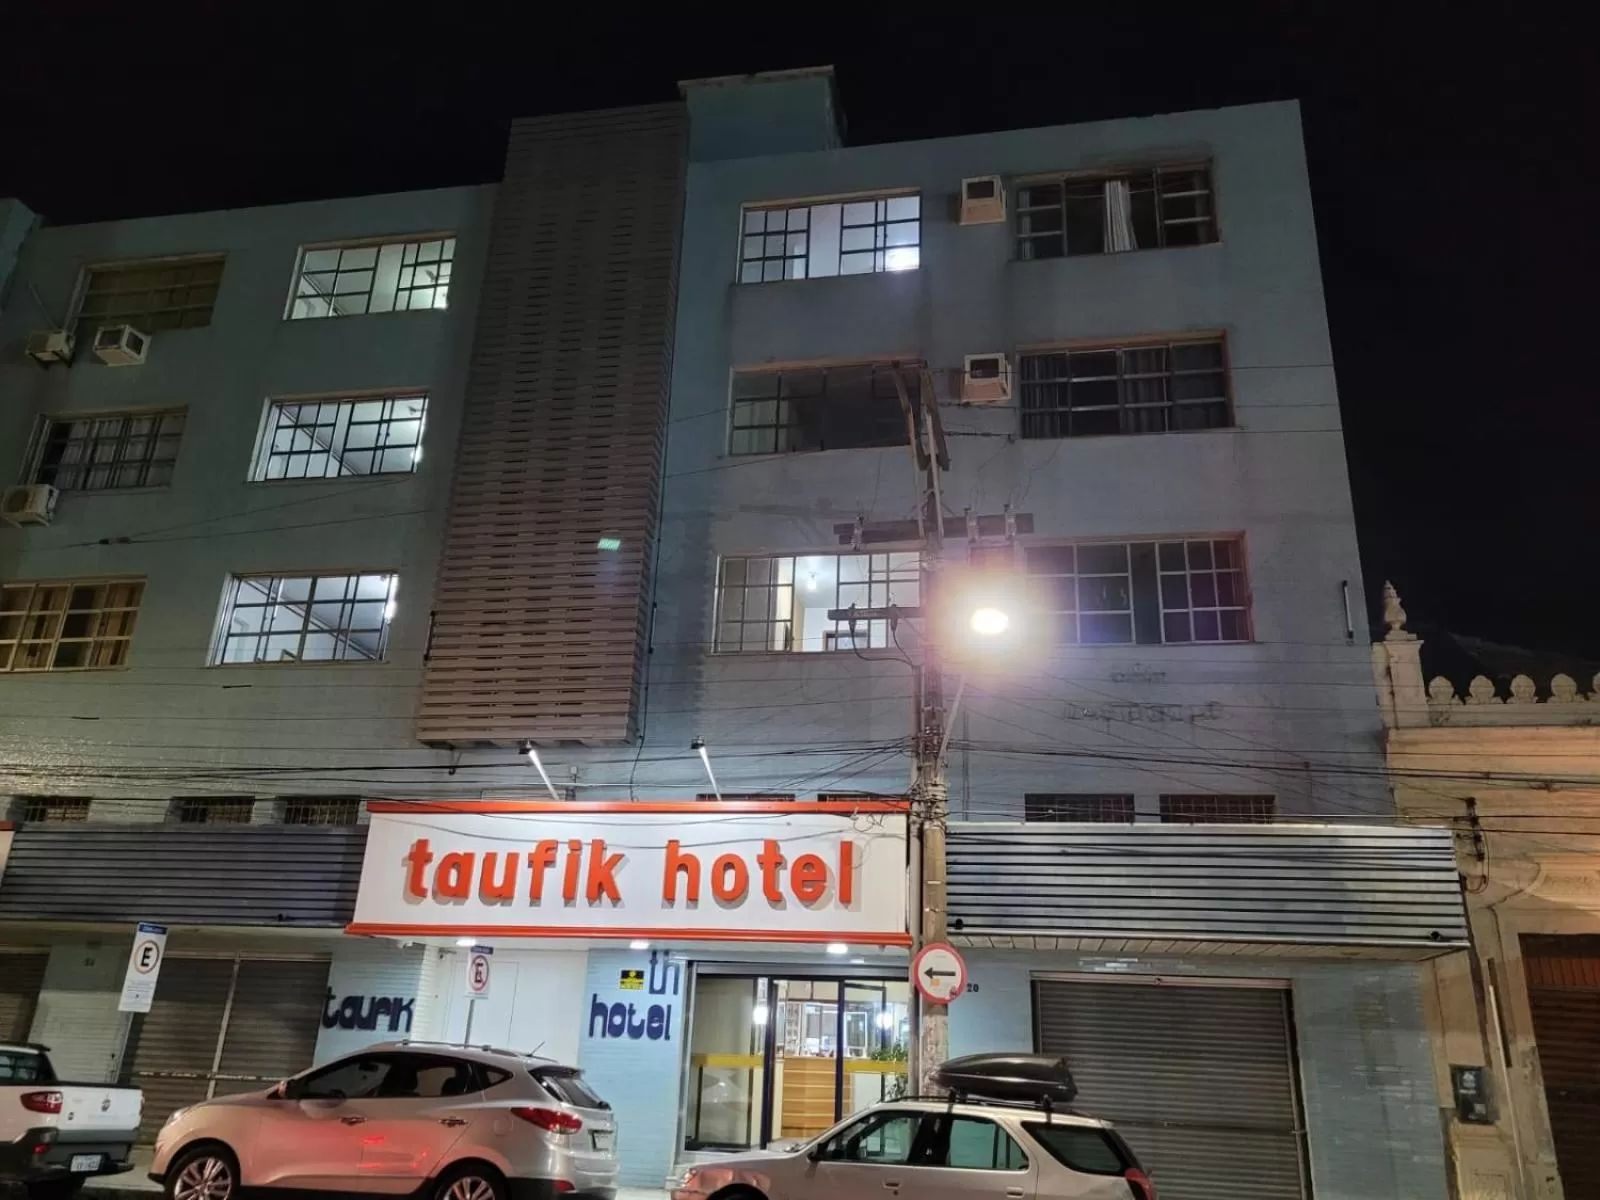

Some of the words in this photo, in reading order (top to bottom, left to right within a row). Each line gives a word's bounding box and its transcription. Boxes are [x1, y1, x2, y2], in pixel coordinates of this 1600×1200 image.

[407, 838, 624, 903] taufik
[664, 838, 853, 906] hotel
[140, 946, 153, 968] E
[589, 993, 672, 1041] hotel
